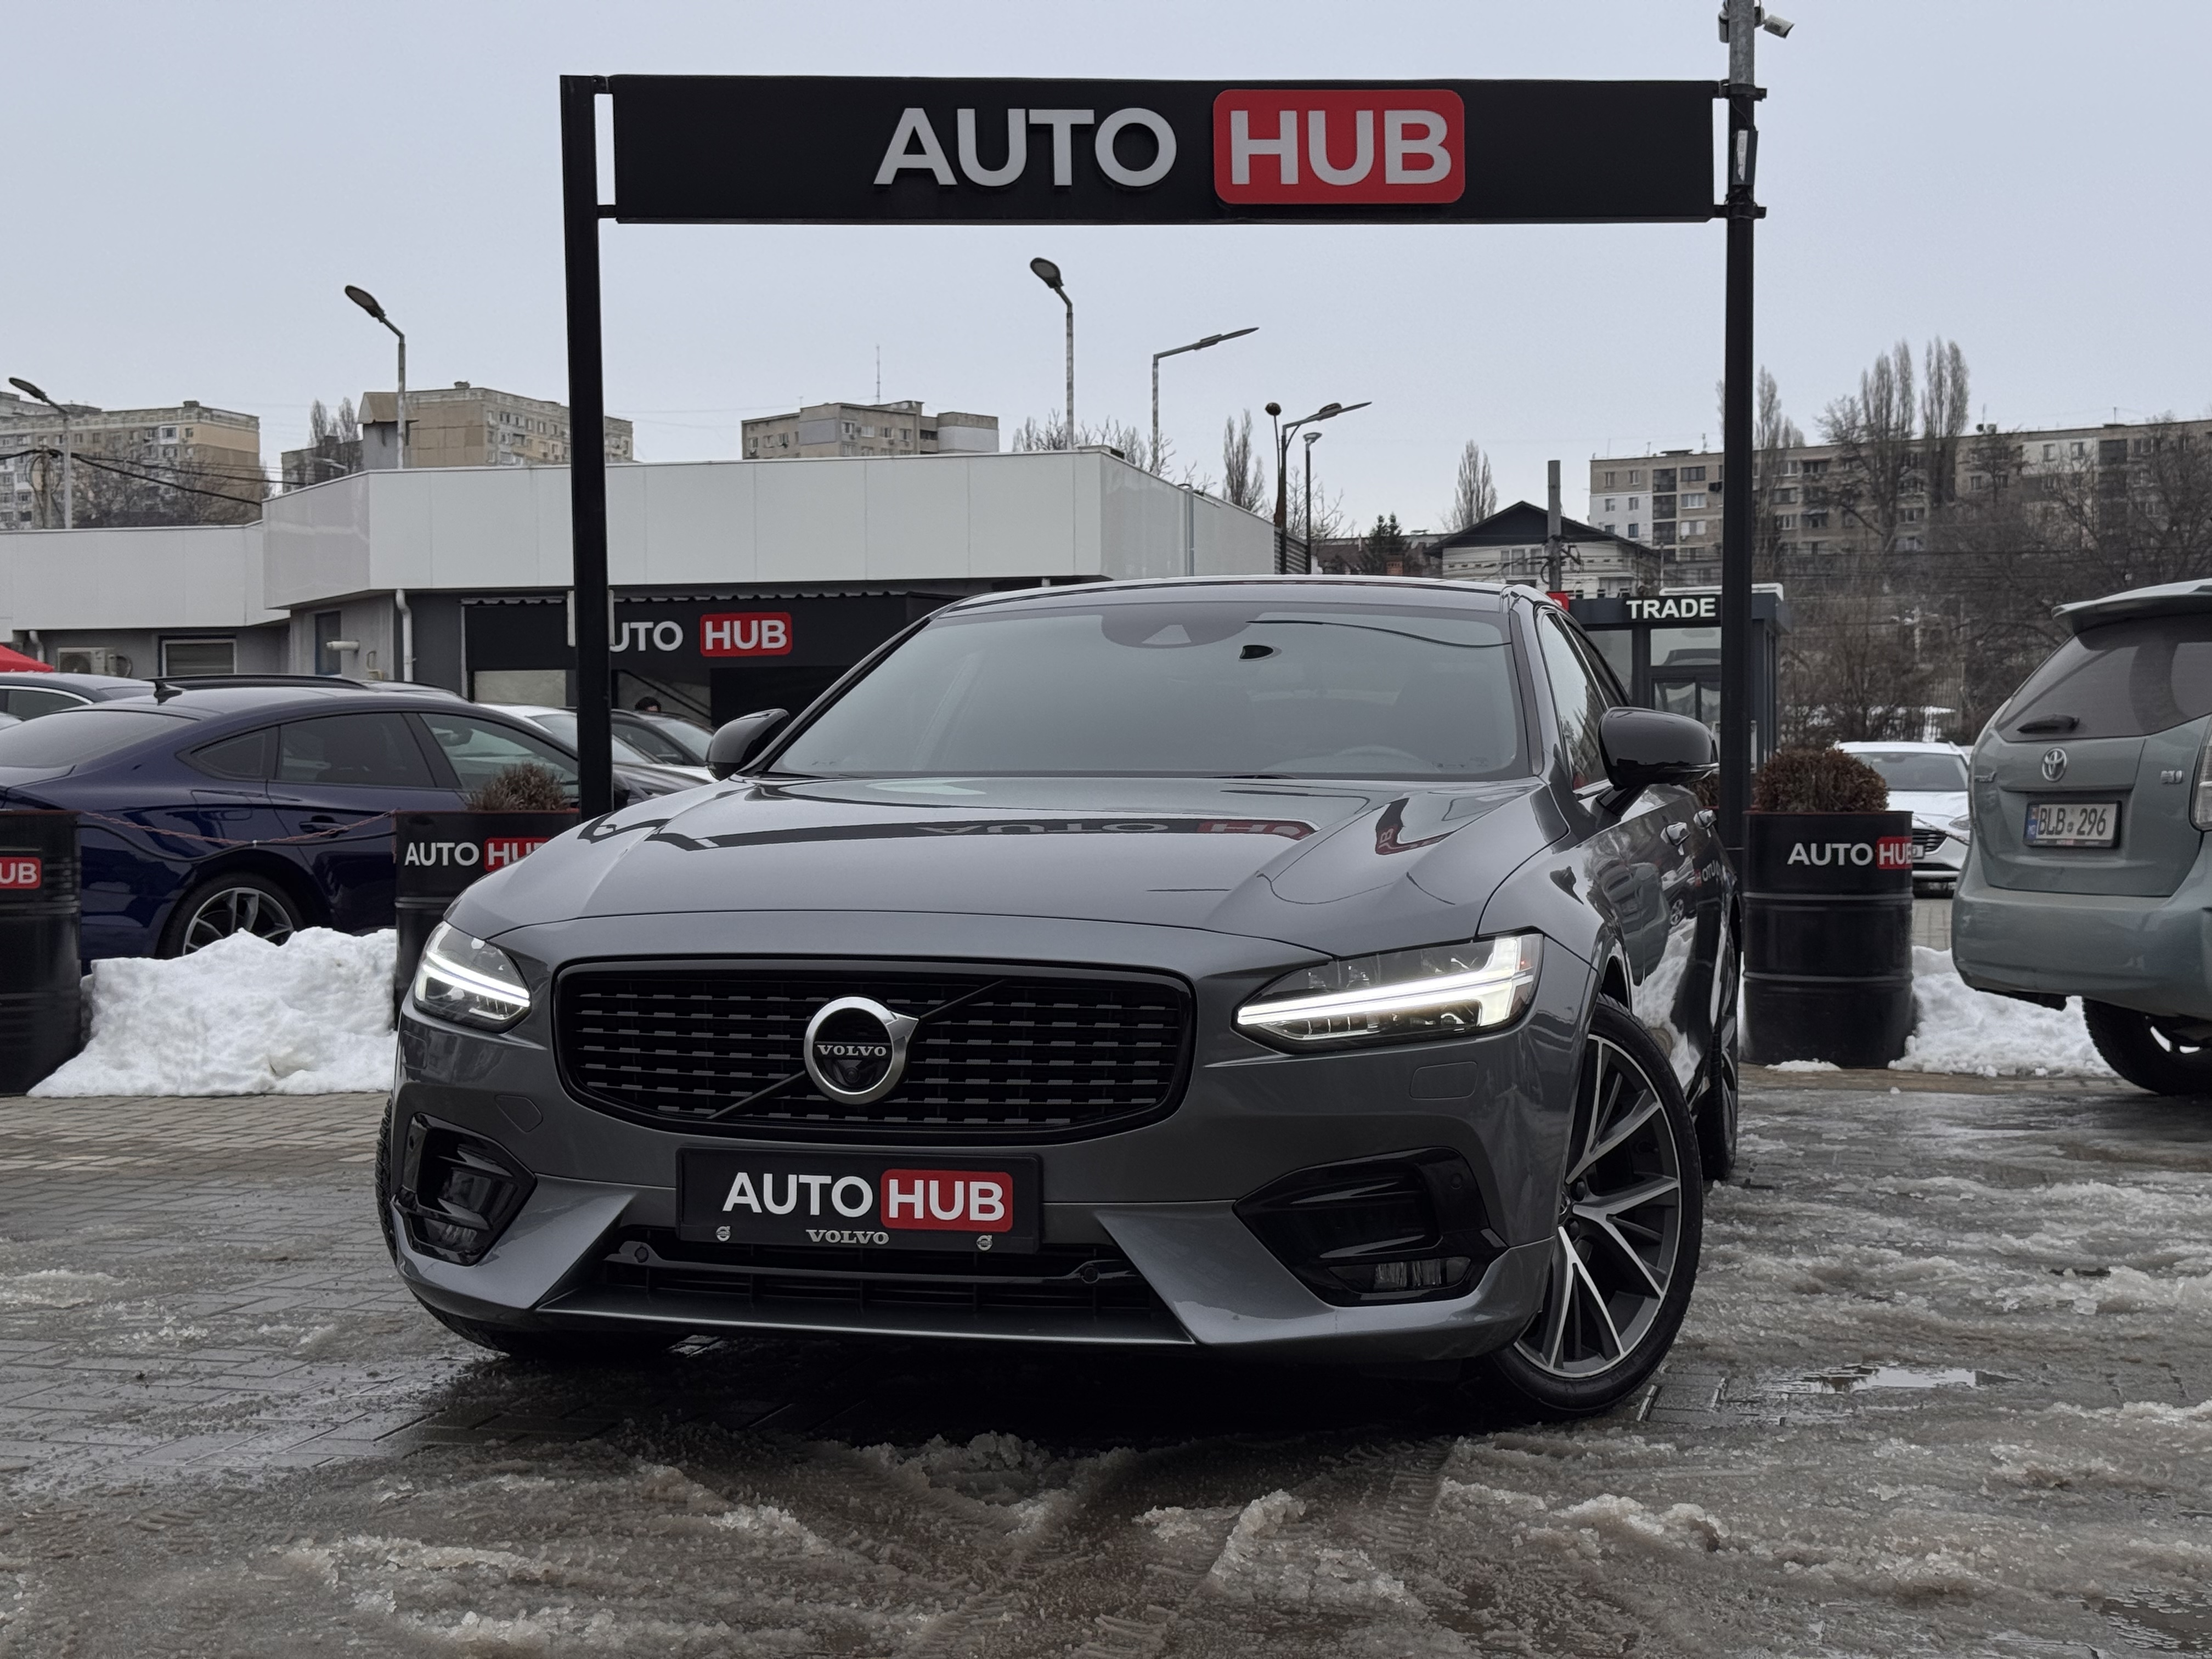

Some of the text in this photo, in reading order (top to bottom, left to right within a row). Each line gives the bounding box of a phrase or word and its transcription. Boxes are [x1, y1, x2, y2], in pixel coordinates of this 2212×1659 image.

[873, 108, 1452, 188] AUTO HUB
[1626, 598, 1716, 619] TRADE
[610, 620, 787, 652] UTO HUB
[2038, 808, 2066, 836] BLB
[2076, 808, 2106, 836] 296
[404, 842, 545, 866] AUTO HU
[1787, 843, 1874, 866] AUTO
[0, 862, 37, 884] UB
[817, 1045, 887, 1057] VOLVO
[723, 1172, 1005, 1221] AUTO HUB
[805, 1229, 889, 1245] VOLVO
